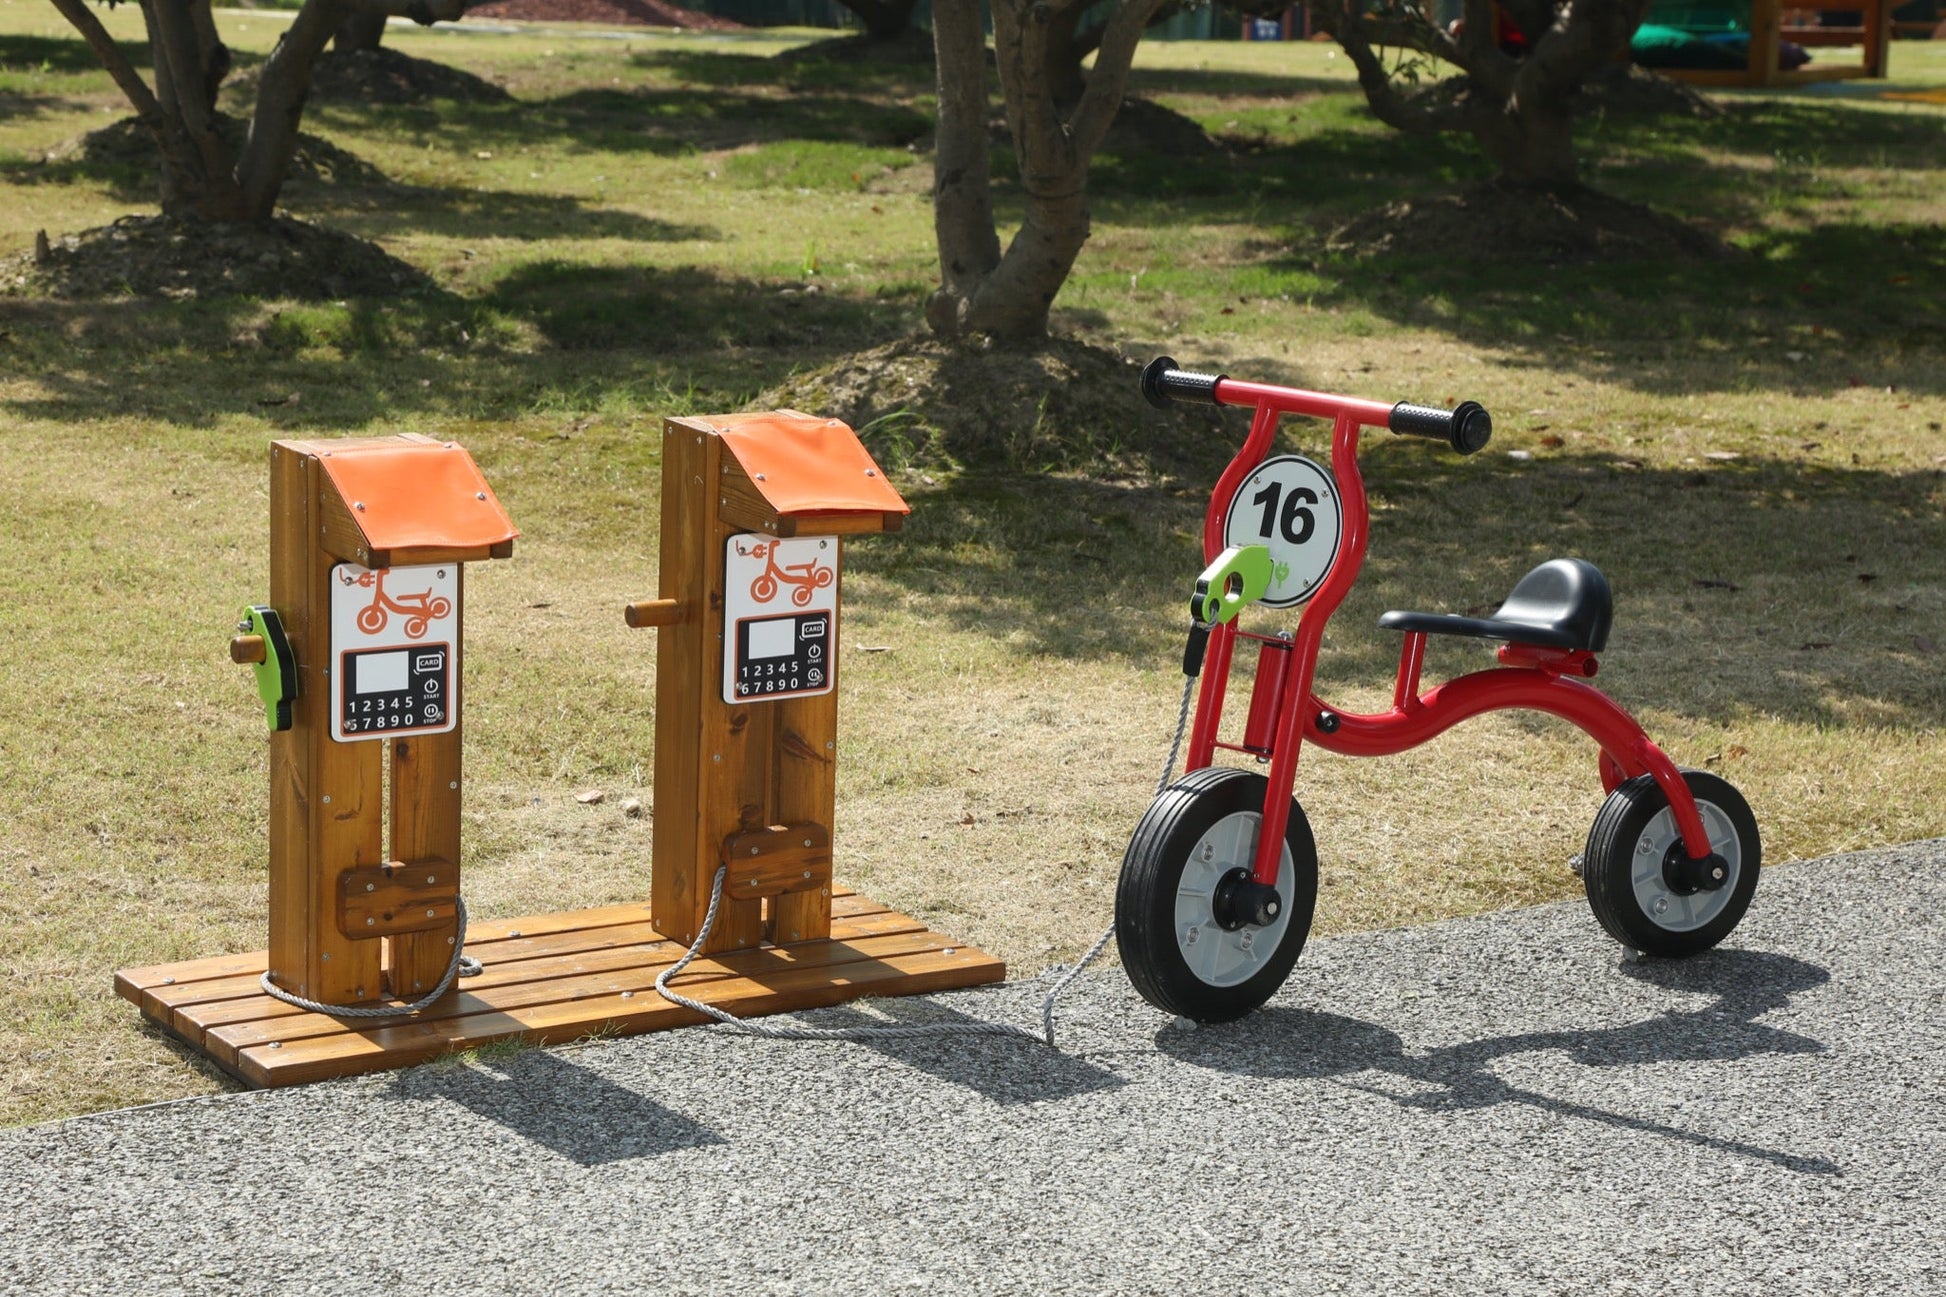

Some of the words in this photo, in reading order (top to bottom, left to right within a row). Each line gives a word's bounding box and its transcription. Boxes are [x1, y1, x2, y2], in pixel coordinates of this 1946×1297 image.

[1253, 481, 1319, 545] 16
[419, 658, 439, 667] CARD
[742, 666, 748, 678] 1
[754, 665, 762, 676] 2
[766, 664, 774, 675] 3
[778, 662, 787, 673] 4
[791, 661, 798, 672] 5
[741, 683, 749, 695] 6
[754, 682, 762, 693] 7
[766, 680, 774, 692] 8
[778, 679, 786, 690] 9
[790, 678, 798, 689] 0
[349, 701, 356, 713] 1
[363, 700, 371, 712] 2
[377, 699, 385, 710] 3
[390, 697, 400, 709] 4
[405, 696, 413, 708] 5
[363, 718, 371, 729] 7
[377, 716, 385, 728] 8
[390, 715, 399, 726] 9
[404, 713, 413, 725] 0
